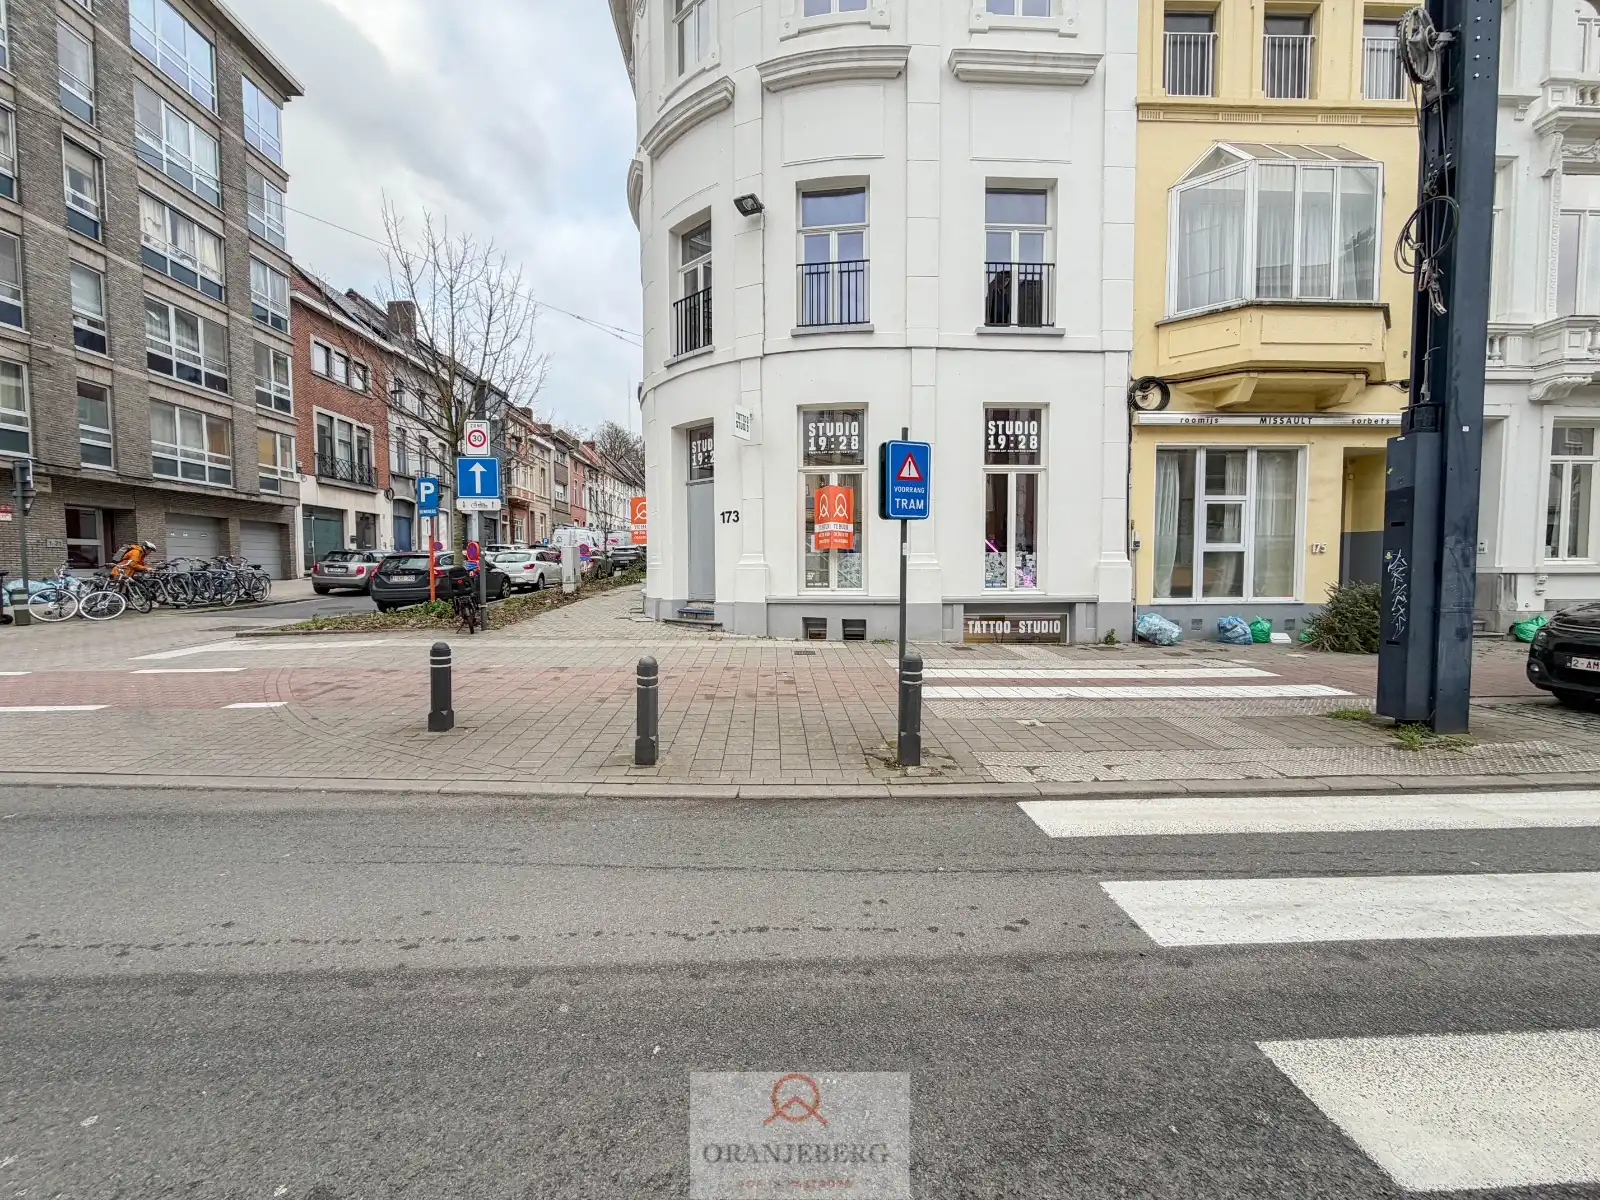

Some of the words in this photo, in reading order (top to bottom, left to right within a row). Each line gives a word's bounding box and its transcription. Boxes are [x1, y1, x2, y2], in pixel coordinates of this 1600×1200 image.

[988, 420, 1038, 435] STUDIO
[1180, 417, 1219, 425] roomijs
[1259, 416, 1313, 425] MISSAULT
[1351, 417, 1390, 425] sorbets
[808, 421, 859, 436] STUDIO
[471, 434, 483, 442] 30
[808, 436, 859, 451] 19:28
[988, 435, 1038, 450] 19:28
[420, 481, 435, 503] P
[893, 486, 925, 494] VOORRANG
[894, 498, 924, 510] TRAM
[719, 510, 740, 524] 173
[1311, 542, 1327, 554] 175
[967, 620, 1011, 634] TATTOO
[1018, 620, 1061, 634] STUDIO
